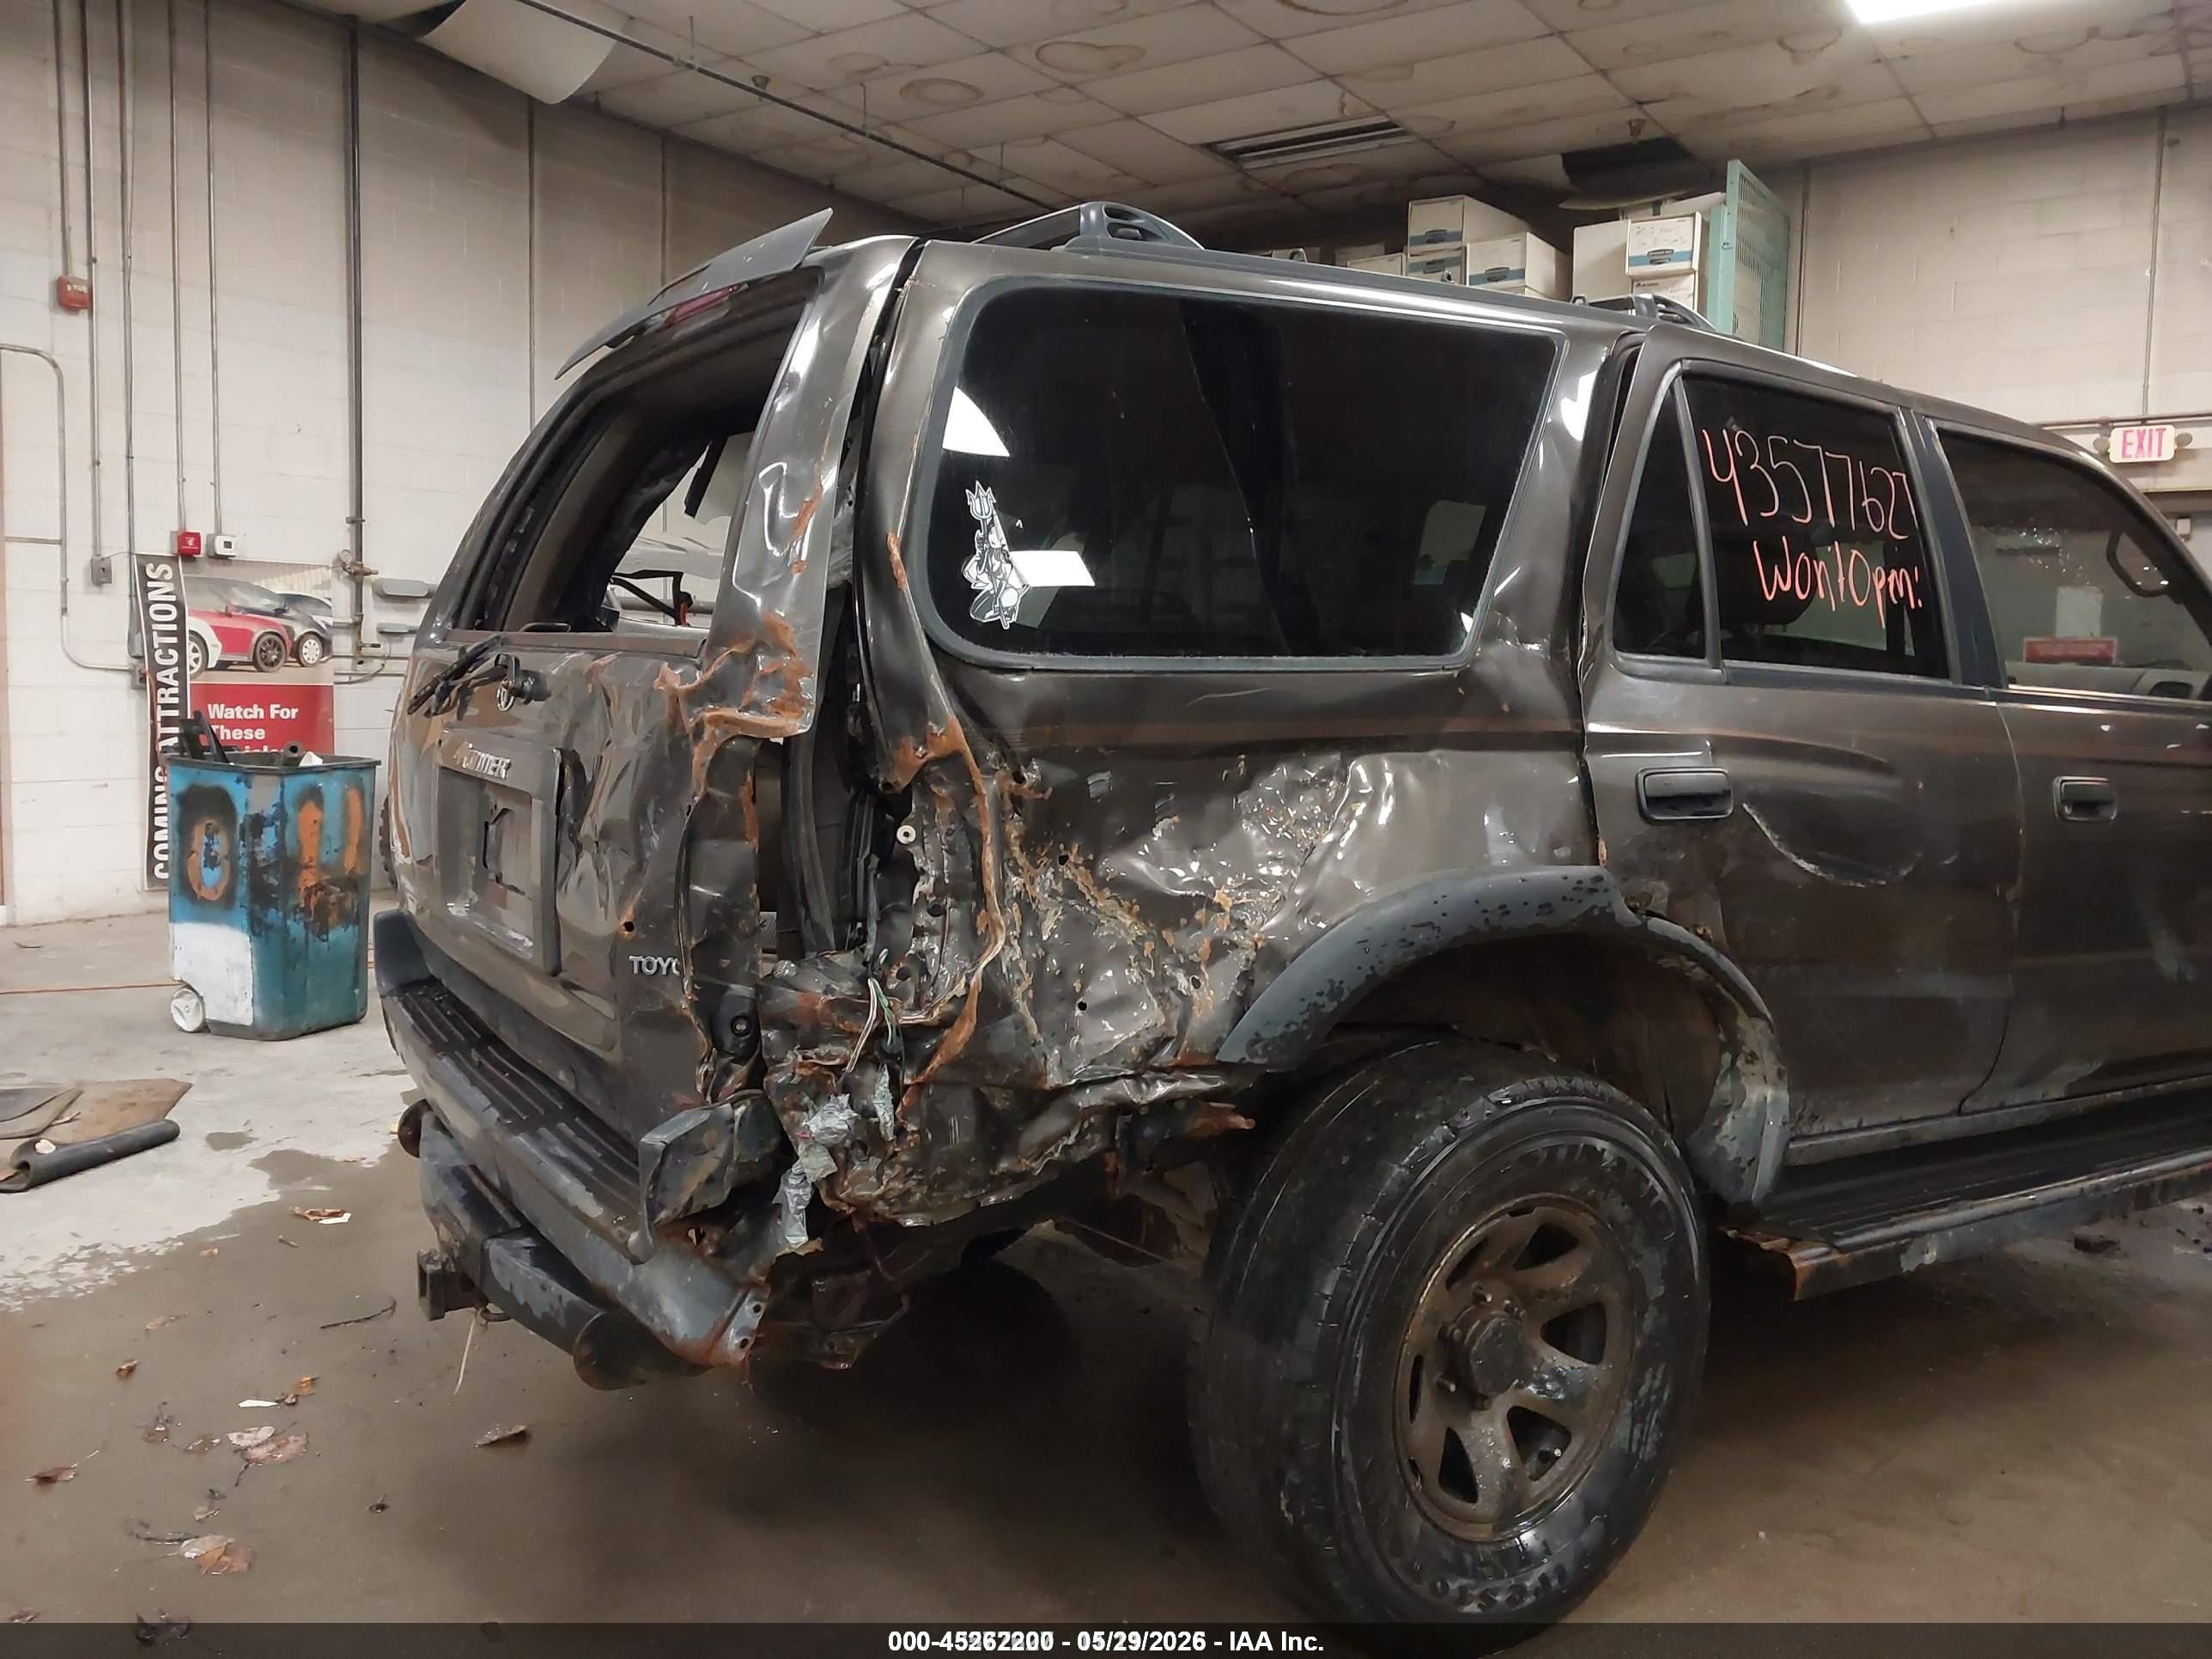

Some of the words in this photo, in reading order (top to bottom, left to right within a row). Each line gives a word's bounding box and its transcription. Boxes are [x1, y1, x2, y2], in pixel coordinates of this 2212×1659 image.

[2121, 428, 2167, 459] EXIT
[1702, 428, 1920, 540] 43577627
[145, 562, 179, 753] ATTRACTIONS
[207, 703, 264, 720] Watch
[270, 703, 299, 720] For
